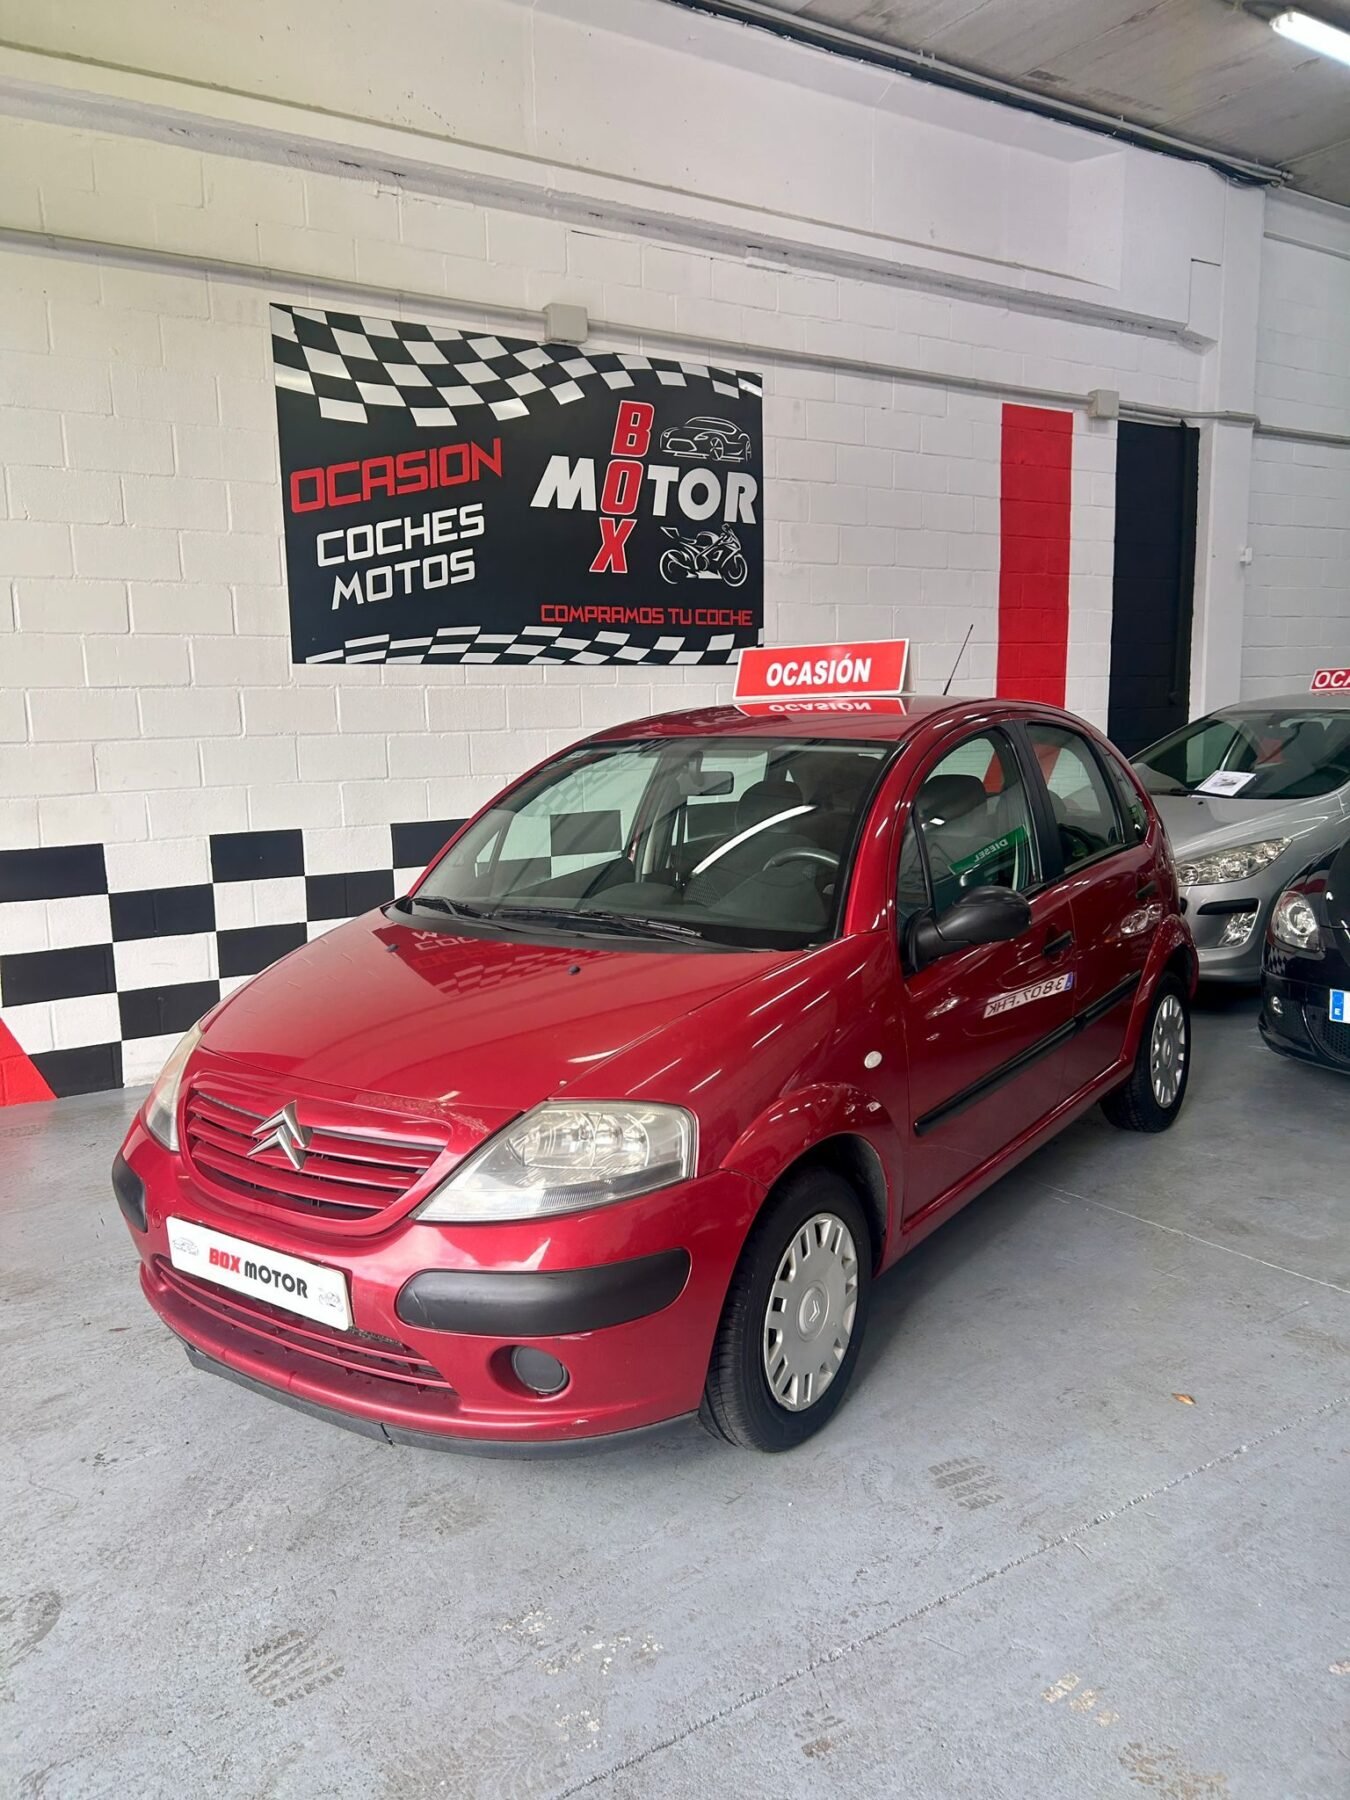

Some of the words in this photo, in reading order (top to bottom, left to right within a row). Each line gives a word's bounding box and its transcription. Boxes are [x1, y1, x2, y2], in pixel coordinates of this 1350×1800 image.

[290, 438, 503, 513] OCASION
[589, 400, 655, 573] BOX
[316, 503, 485, 567] COCHES
[331, 548, 476, 611] MOTOS
[541, 605, 664, 625] COMPRAMOS
[668, 608, 692, 625] TU
[695, 609, 753, 626] COCHE
[766, 654, 872, 687] OCASIÓN
[209, 1247, 241, 1273] BOX
[245, 1260, 308, 1299] MOTOR
